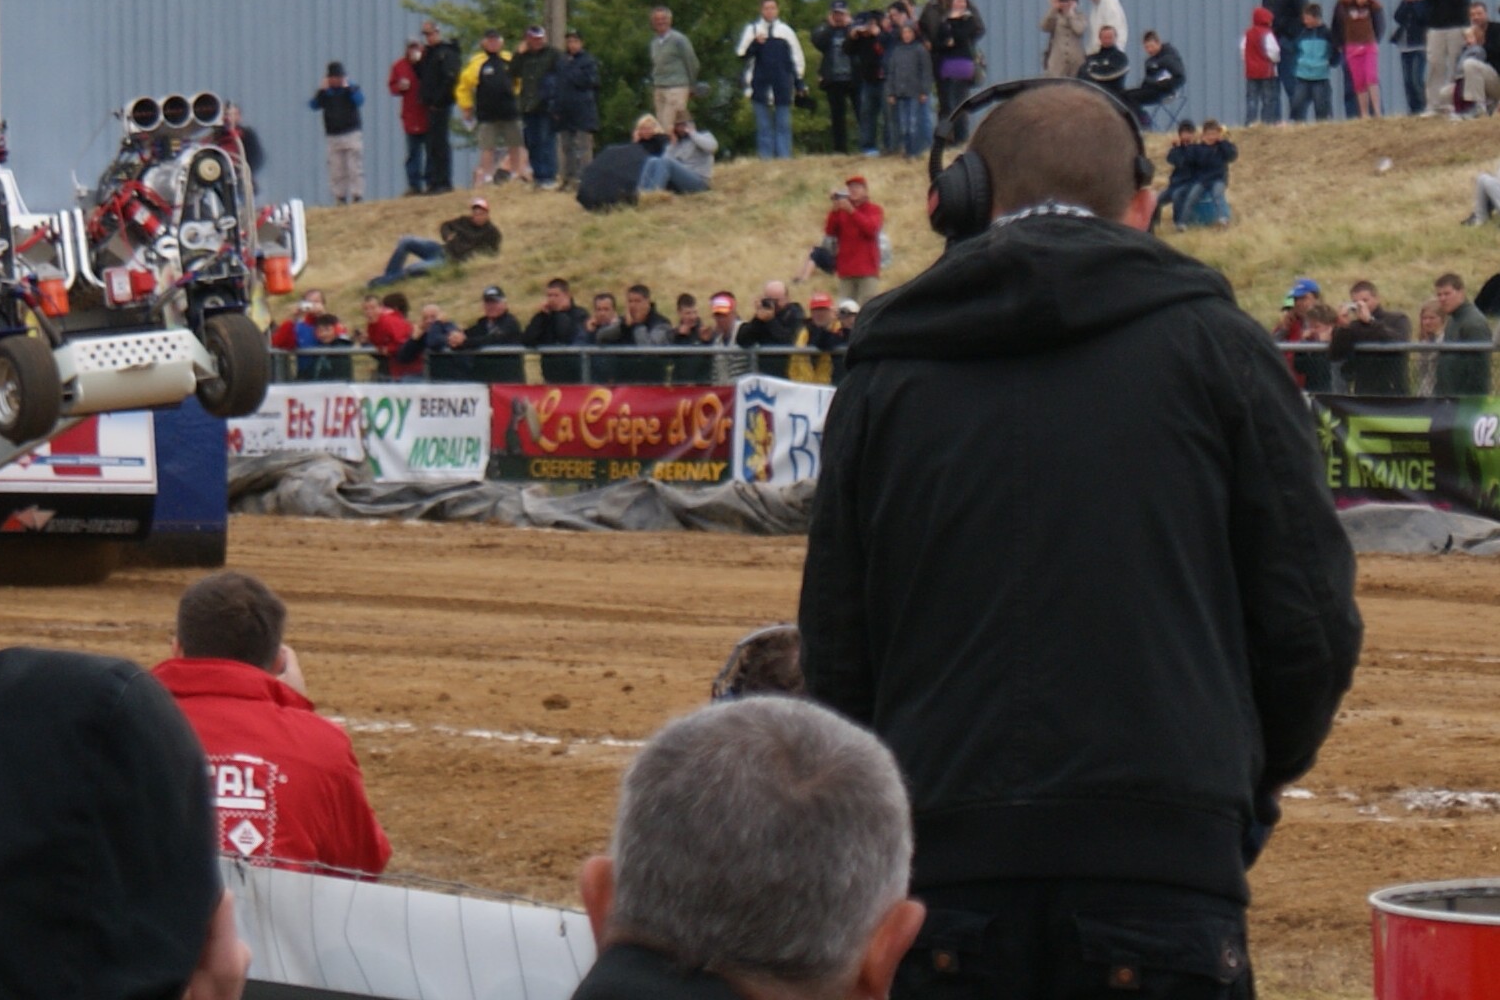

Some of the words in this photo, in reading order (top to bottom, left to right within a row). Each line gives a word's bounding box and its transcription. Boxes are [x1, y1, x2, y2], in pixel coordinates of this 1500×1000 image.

[286, 397, 316, 439] Ets
[420, 397, 479, 418] BERNAY
[580, 387, 661, 456] Crêpe
[530, 459, 596, 479] CREPERIE
[609, 462, 640, 480] BAR
[653, 462, 728, 481] BERNAY
